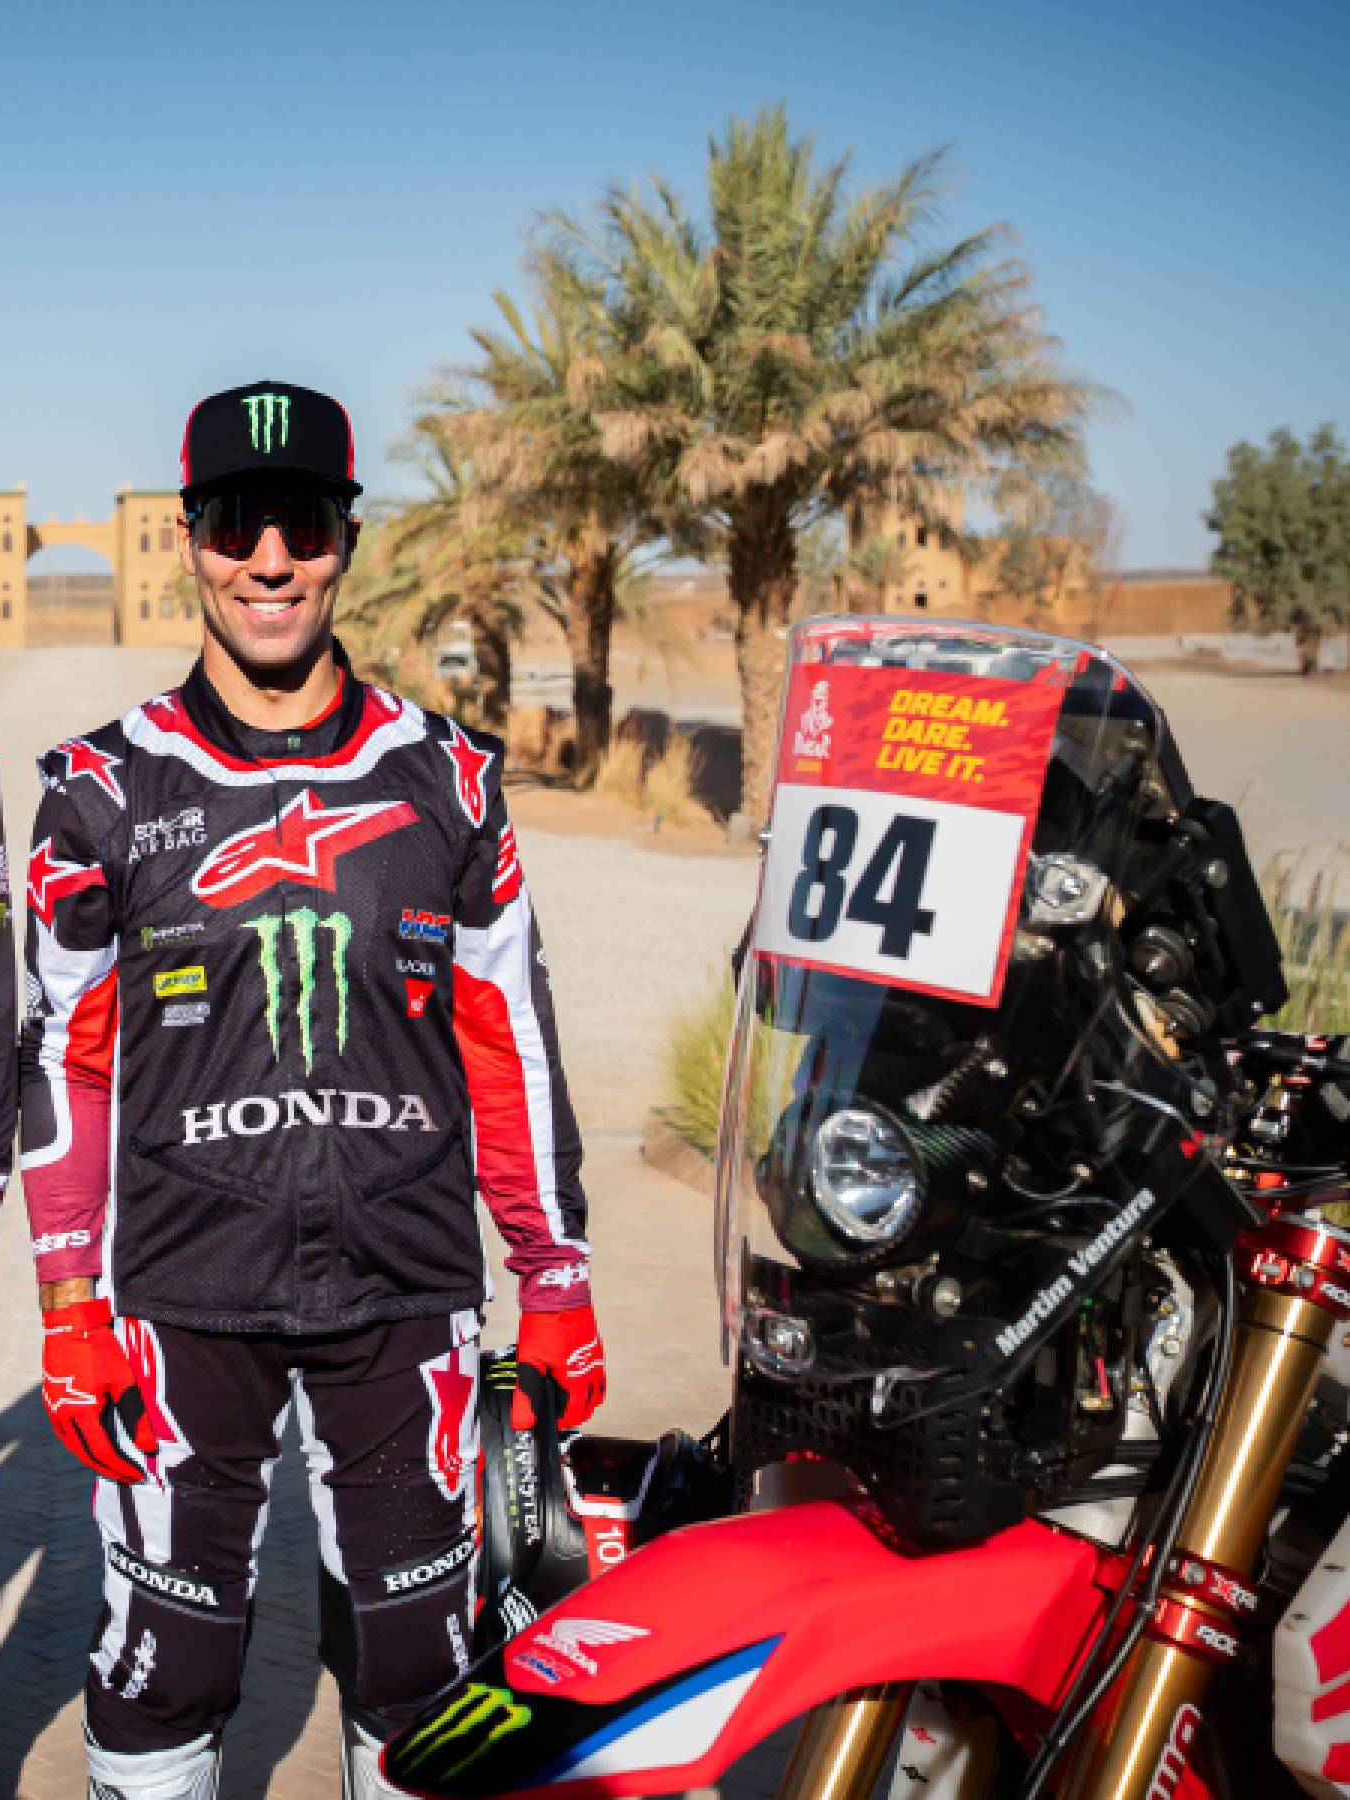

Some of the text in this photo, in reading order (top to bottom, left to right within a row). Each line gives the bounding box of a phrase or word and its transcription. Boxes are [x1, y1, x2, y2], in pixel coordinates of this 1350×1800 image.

[882, 717, 972, 751] DARE.
[889, 689, 1010, 727] DREAM.
[876, 743, 986, 784] LIVE IT.
[788, 803, 939, 961] 84
[181, 1089, 441, 1146] HONDA
[996, 1188, 1156, 1357] Martim Ventura
[110, 1547, 220, 1607] HONDA
[383, 1539, 478, 1594] HOND
